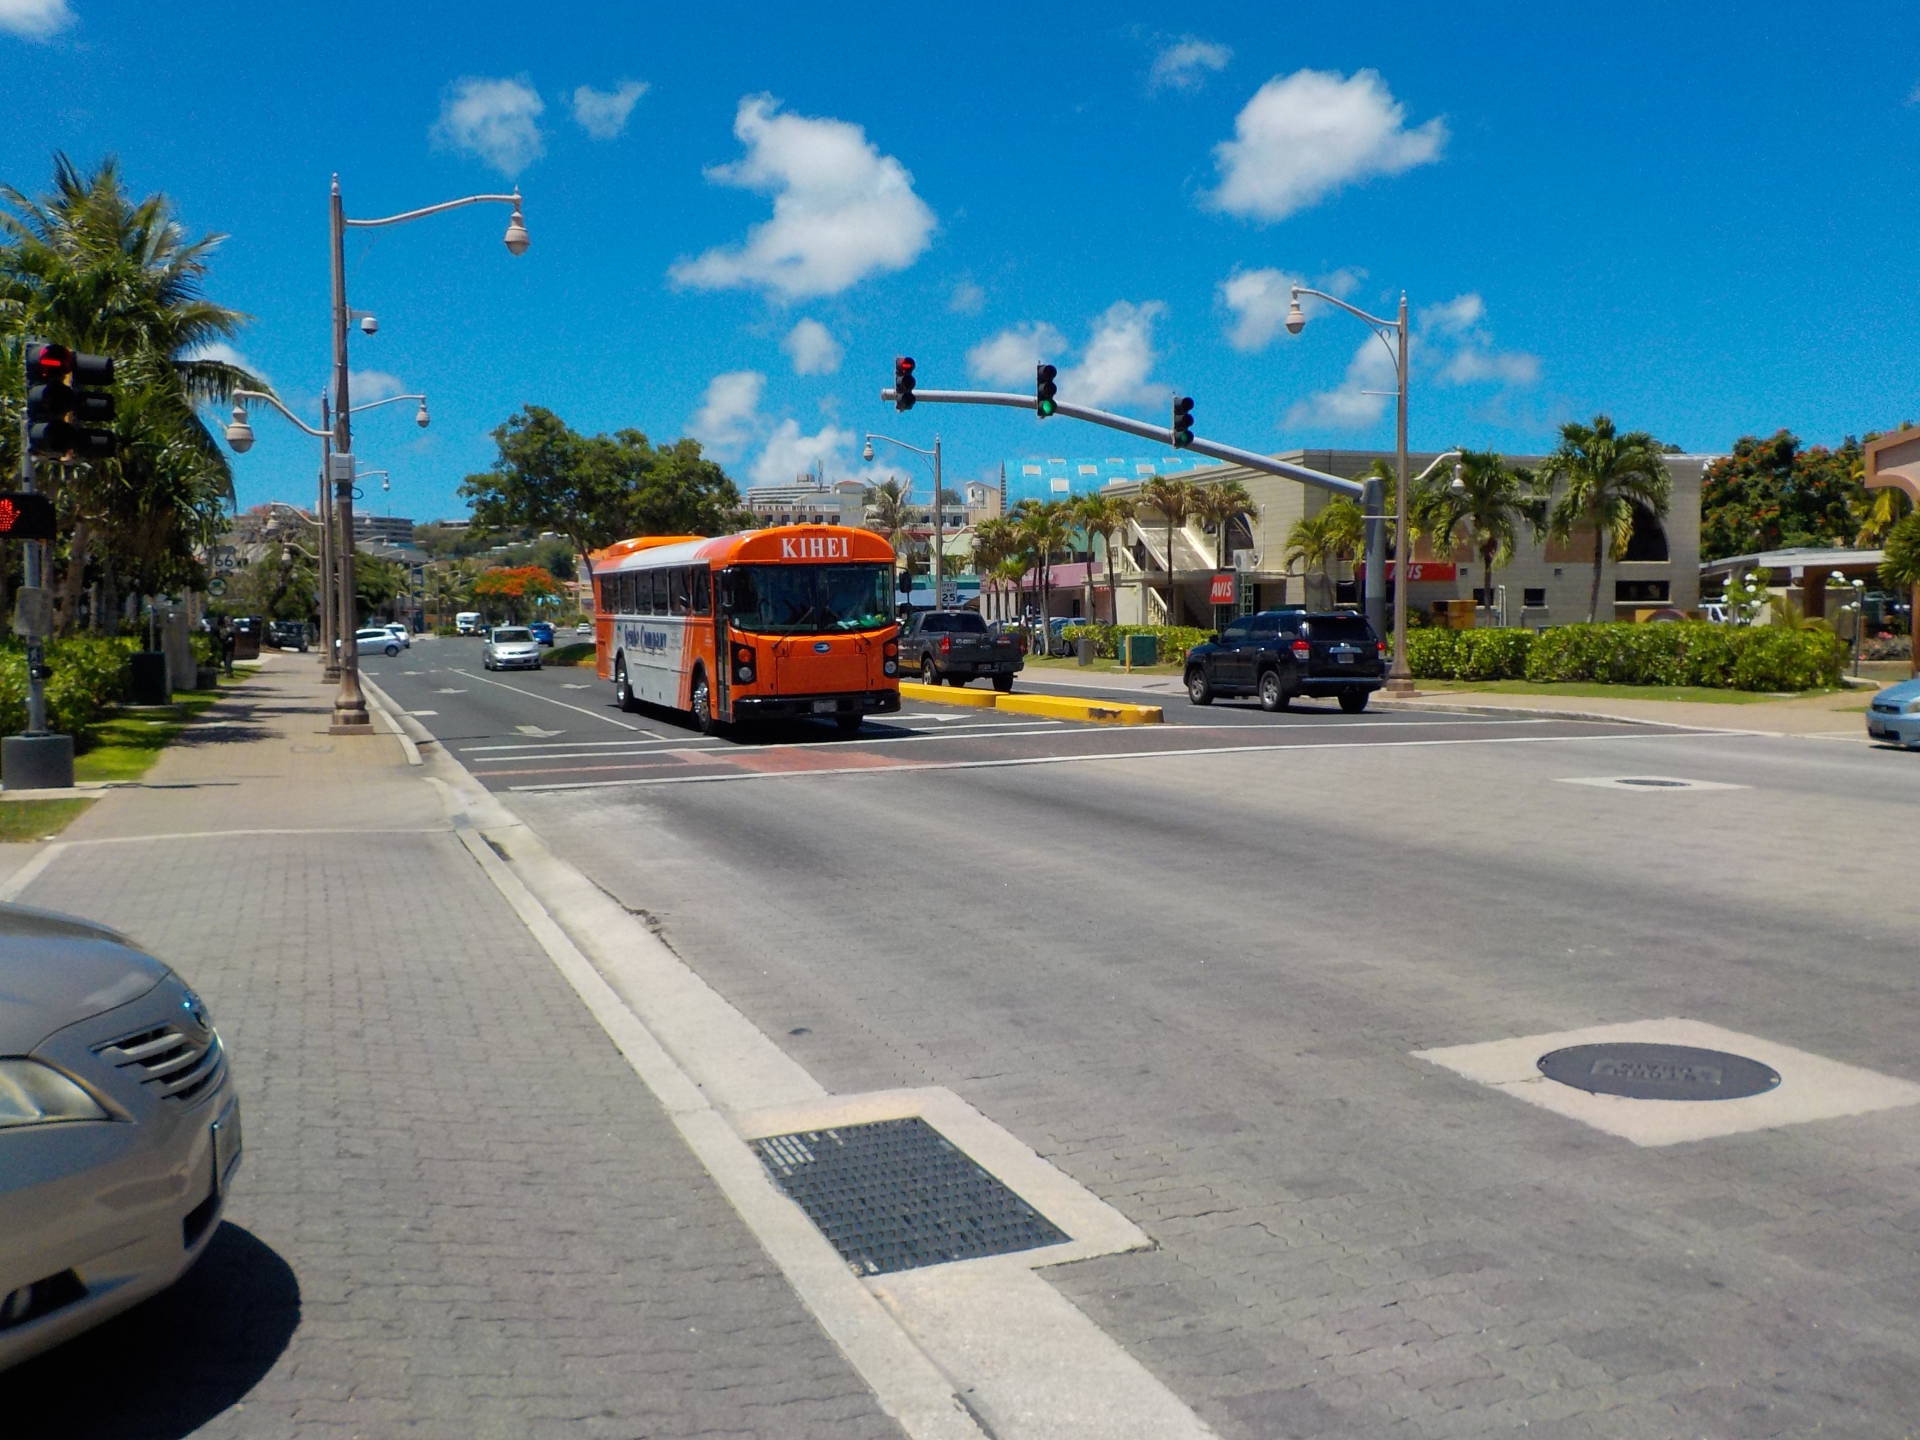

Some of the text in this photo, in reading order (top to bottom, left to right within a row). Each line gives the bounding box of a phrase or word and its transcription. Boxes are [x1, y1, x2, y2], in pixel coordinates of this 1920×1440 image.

[781, 537, 849, 558] KIHEI
[214, 554, 233, 567] 66
[1389, 564, 1423, 579] AIS
[1210, 581, 1232, 597] AVIS
[942, 593, 956, 602] 25
